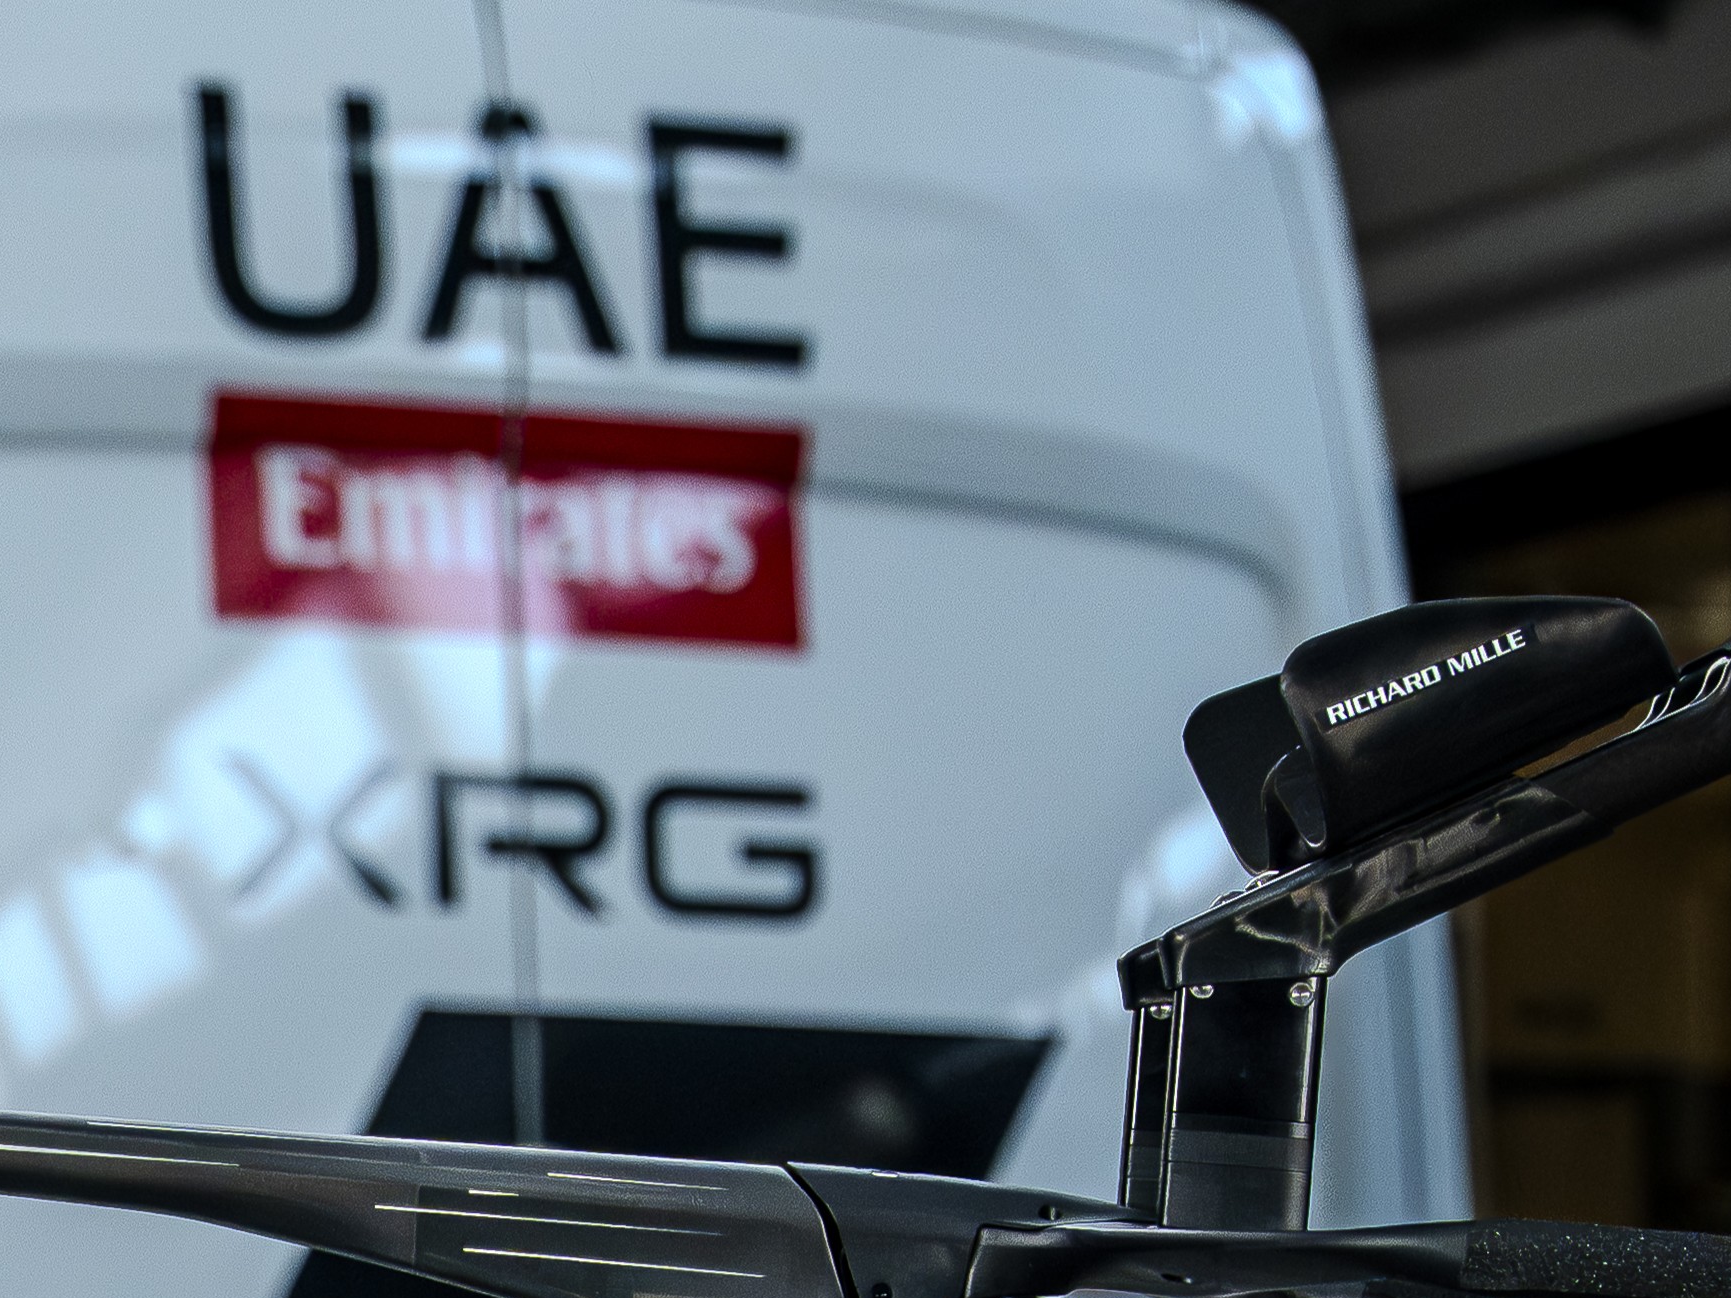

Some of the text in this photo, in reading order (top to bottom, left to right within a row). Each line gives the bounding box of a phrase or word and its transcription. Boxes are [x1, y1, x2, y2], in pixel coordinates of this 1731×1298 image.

[190, 76, 813, 369] UAE
[258, 440, 759, 594] Emirates
[1326, 628, 1527, 725] RICHARD MILLE
[227, 750, 825, 923] XRG
